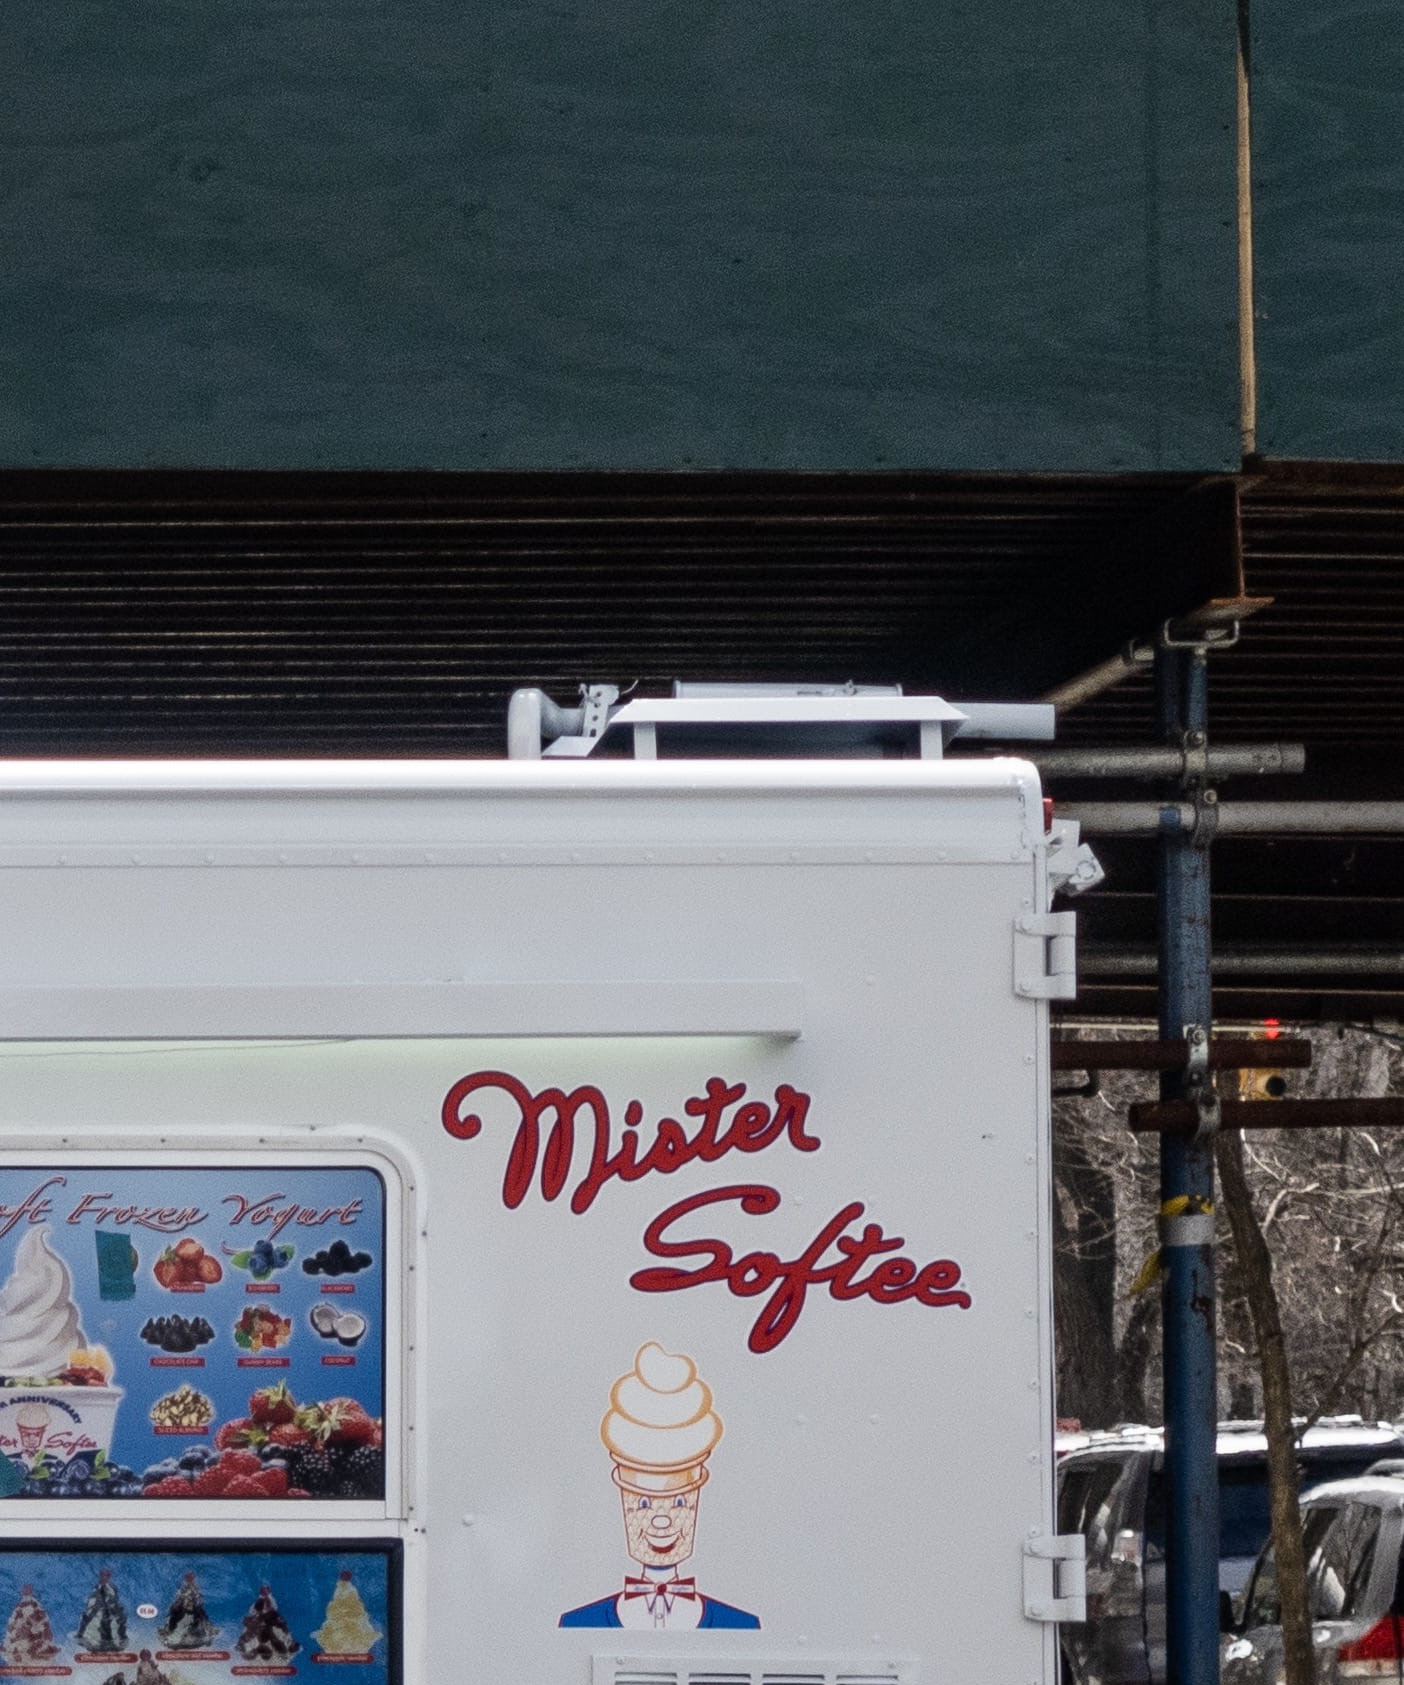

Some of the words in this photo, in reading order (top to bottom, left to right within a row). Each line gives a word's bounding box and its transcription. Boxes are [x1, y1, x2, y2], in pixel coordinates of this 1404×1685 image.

[441, 1070, 822, 1215] Mister
[65, 1192, 212, 1233] Frozen
[220, 1192, 364, 1258] Yogurt
[629, 1184, 973, 1354] Softee
